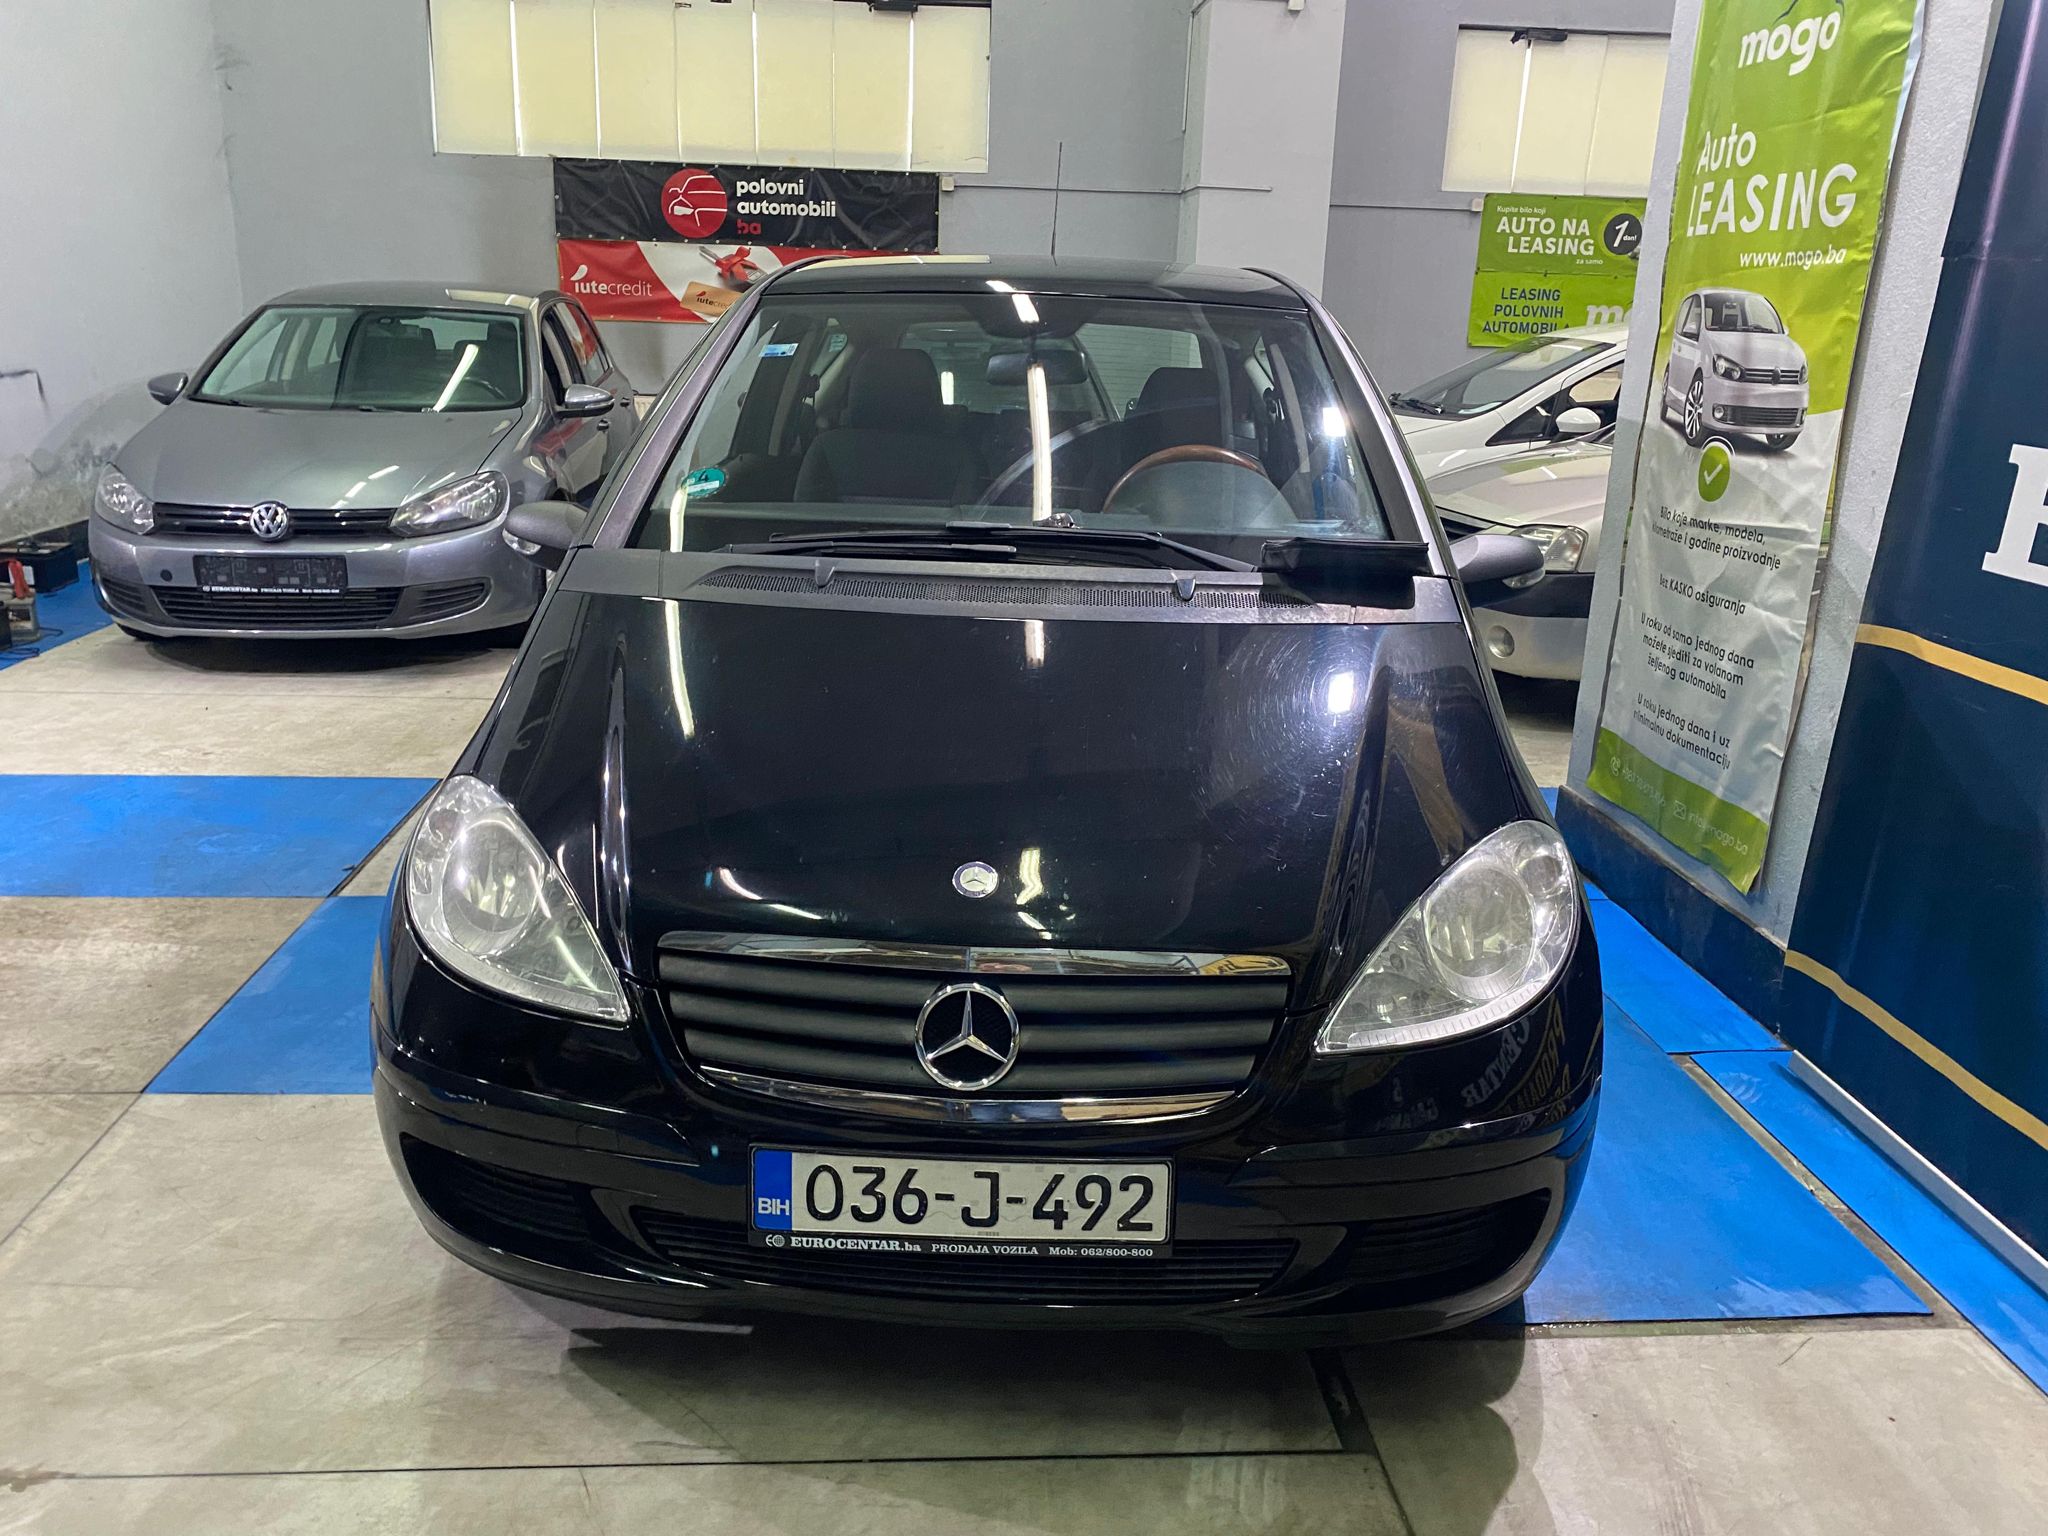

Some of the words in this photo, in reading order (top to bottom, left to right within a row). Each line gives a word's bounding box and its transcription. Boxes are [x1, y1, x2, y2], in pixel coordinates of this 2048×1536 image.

[1738, 11, 1840, 76] mogo
[1696, 123, 1757, 175] Auto
[736, 178, 804, 196] polovni
[1686, 163, 1858, 238] LEASING
[736, 200, 836, 218] automobili
[1496, 205, 1519, 214] Kupite
[1520, 206, 1533, 214] bilo
[1533, 206, 1547, 215] koji
[1496, 216, 1556, 235] AUTO
[1562, 218, 1591, 236] NA
[1613, 220, 1630, 248] 1
[1623, 234, 1638, 242] dan!
[1507, 236, 1595, 256] LEASING
[1739, 244, 1848, 271] www.mogo.ba
[1500, 287, 1561, 302] LEASING
[1493, 304, 1564, 319] POLOVNIH
[1672, 509, 1687, 527] koje
[1689, 516, 1722, 535] marke,
[1725, 524, 1766, 545] modela,
[1688, 536, 1721, 554] godine
[1722, 544, 1781, 570] proizvodnje
[1669, 578, 1694, 599] KASKO
[1695, 591, 1746, 616] osiguranja
[1641, 612, 1646, 625] U
[1646, 616, 1663, 632] roku
[1663, 624, 1672, 636] od
[1672, 630, 1693, 646] samo
[1694, 635, 1726, 661] jednog
[1727, 650, 1755, 669] dana
[1642, 633, 1667, 653] možete
[1667, 645, 1691, 664] sjediti
[1692, 656, 1702, 669] za
[1704, 660, 1744, 686] volanom
[1679, 670, 1727, 700] automobila
[1637, 692, 1643, 705] U
[1657, 704, 1686, 731] jednog
[1687, 720, 1711, 740] dana
[1719, 736, 1731, 749] uz
[1666, 728, 1731, 770] dokumentaciju
[757, 1196, 790, 1216] BIH
[805, 1163, 1155, 1233] 036-J-492
[790, 1236, 922, 1253] EUROCENTAR.ba
[930, 1242, 990, 1255] PRODAJA
[992, 1244, 1039, 1256] VOZILA
[1048, 1246, 1079, 1257] Mob:
[1080, 1246, 1154, 1257] 062/800-800
